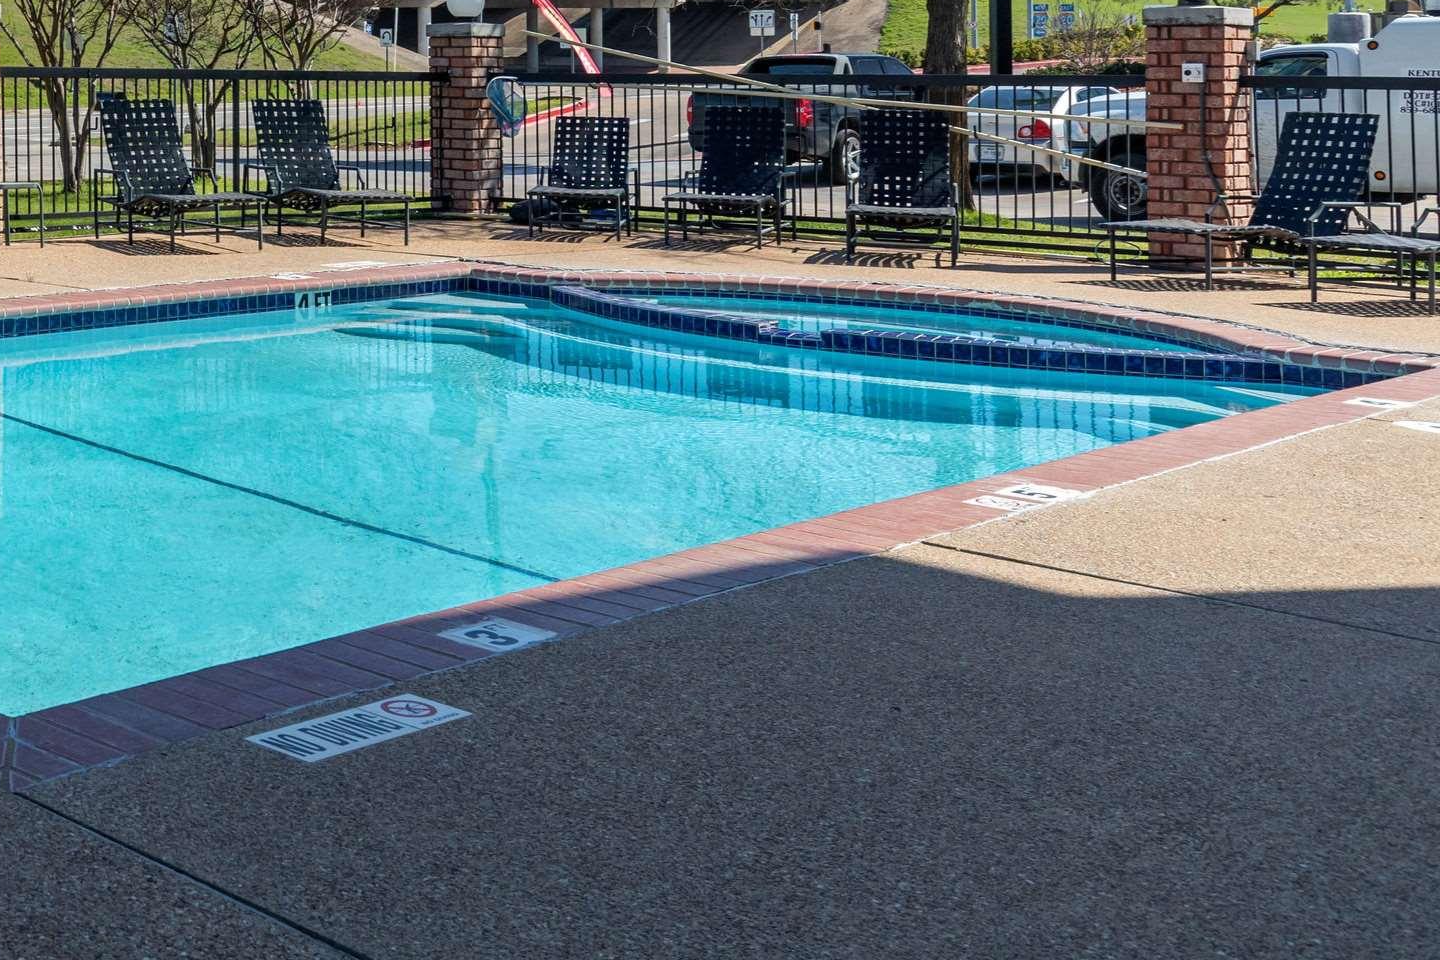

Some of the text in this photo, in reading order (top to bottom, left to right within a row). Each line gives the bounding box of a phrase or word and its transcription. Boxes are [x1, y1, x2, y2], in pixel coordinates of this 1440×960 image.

[314, 292, 331, 308] FT
[1011, 489, 1058, 499] 5
[464, 629, 520, 646] 3
[261, 733, 327, 757] NO
[298, 712, 404, 747] DIVING
